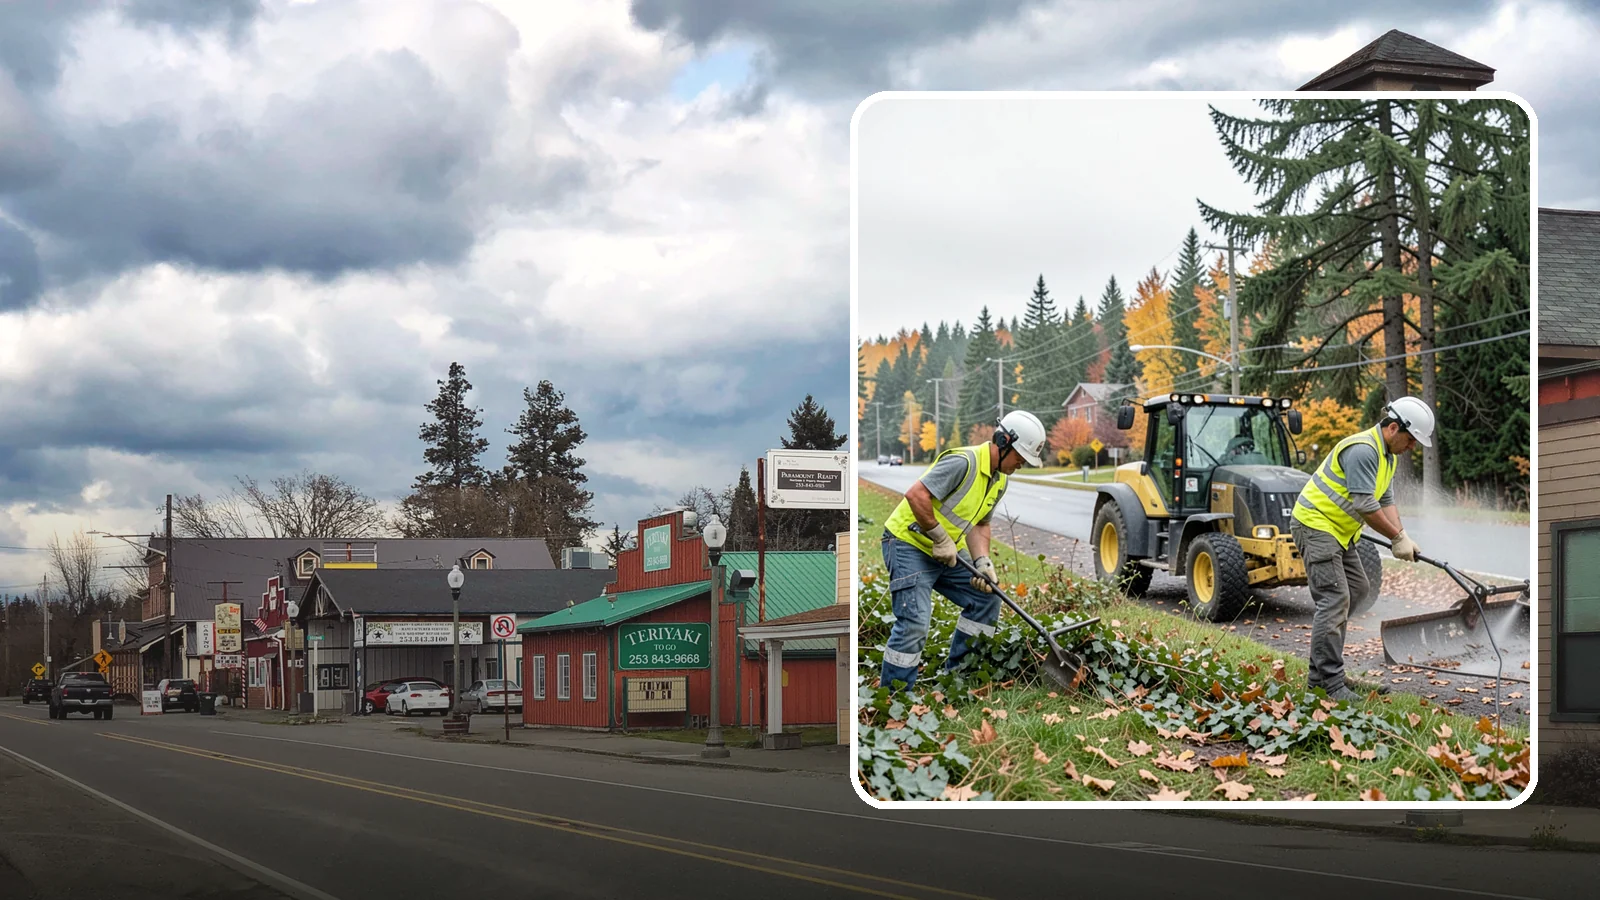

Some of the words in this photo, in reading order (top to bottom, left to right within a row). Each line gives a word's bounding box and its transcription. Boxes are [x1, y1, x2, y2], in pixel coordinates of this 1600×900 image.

[624, 627, 702, 646] TERIYAKI
[629, 654, 648, 664] 253
[651, 653, 700, 664] 843-9668
